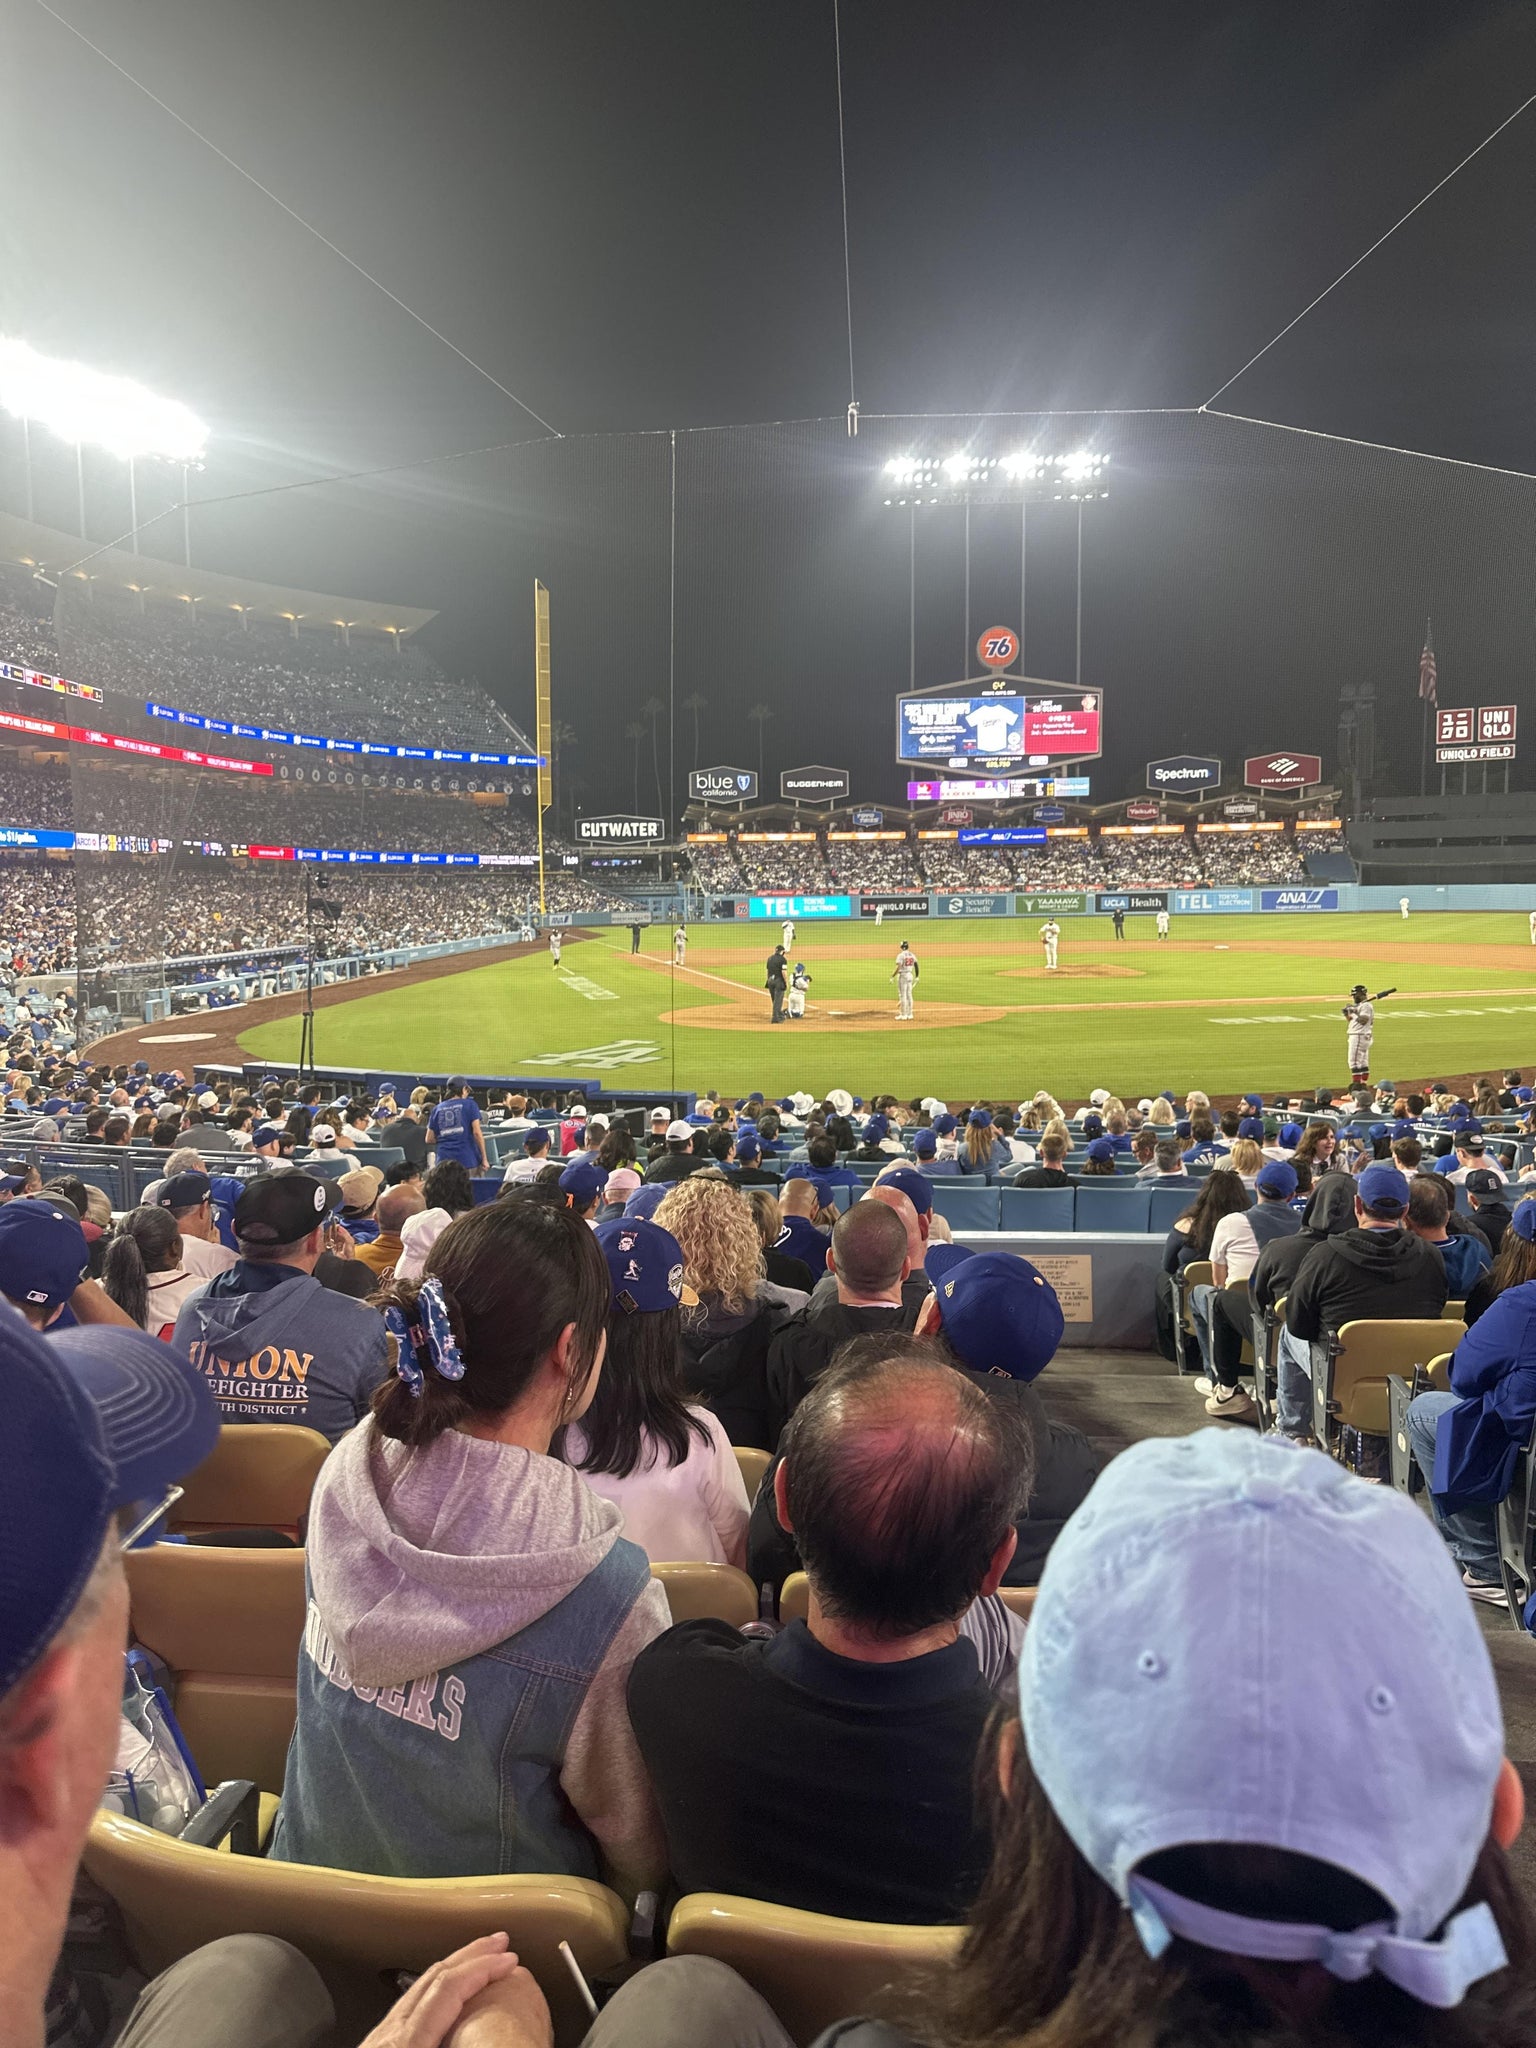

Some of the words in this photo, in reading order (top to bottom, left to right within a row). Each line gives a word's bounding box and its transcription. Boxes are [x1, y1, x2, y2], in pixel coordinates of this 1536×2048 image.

[985, 636, 1012, 658] 76
[1442, 713, 1468, 726] ユニ
[1483, 711, 1509, 723] UNI
[1441, 726, 1468, 739] クロ
[1483, 723, 1511, 738] QLO
[1440, 749, 1478, 760] UNIQLO
[1479, 747, 1511, 758] FIELD
[696, 774, 733, 789] blue
[1155, 768, 1209, 782] Spectrum
[787, 780, 843, 788] GUGGENHEIM
[702, 789, 738, 797] california
[581, 822, 658, 837] CUTWATER
[965, 898, 995, 906] Security
[1104, 899, 1126, 907] UCLA
[1131, 898, 1162, 907] Health
[1178, 894, 1213, 909] TEL
[1276, 892, 1306, 904] ANA
[762, 898, 800, 916] TEL
[905, 903, 928, 911] FIELD
[965, 905, 992, 914] Benefit
[239, 1403, 297, 1415] DISTRICT
